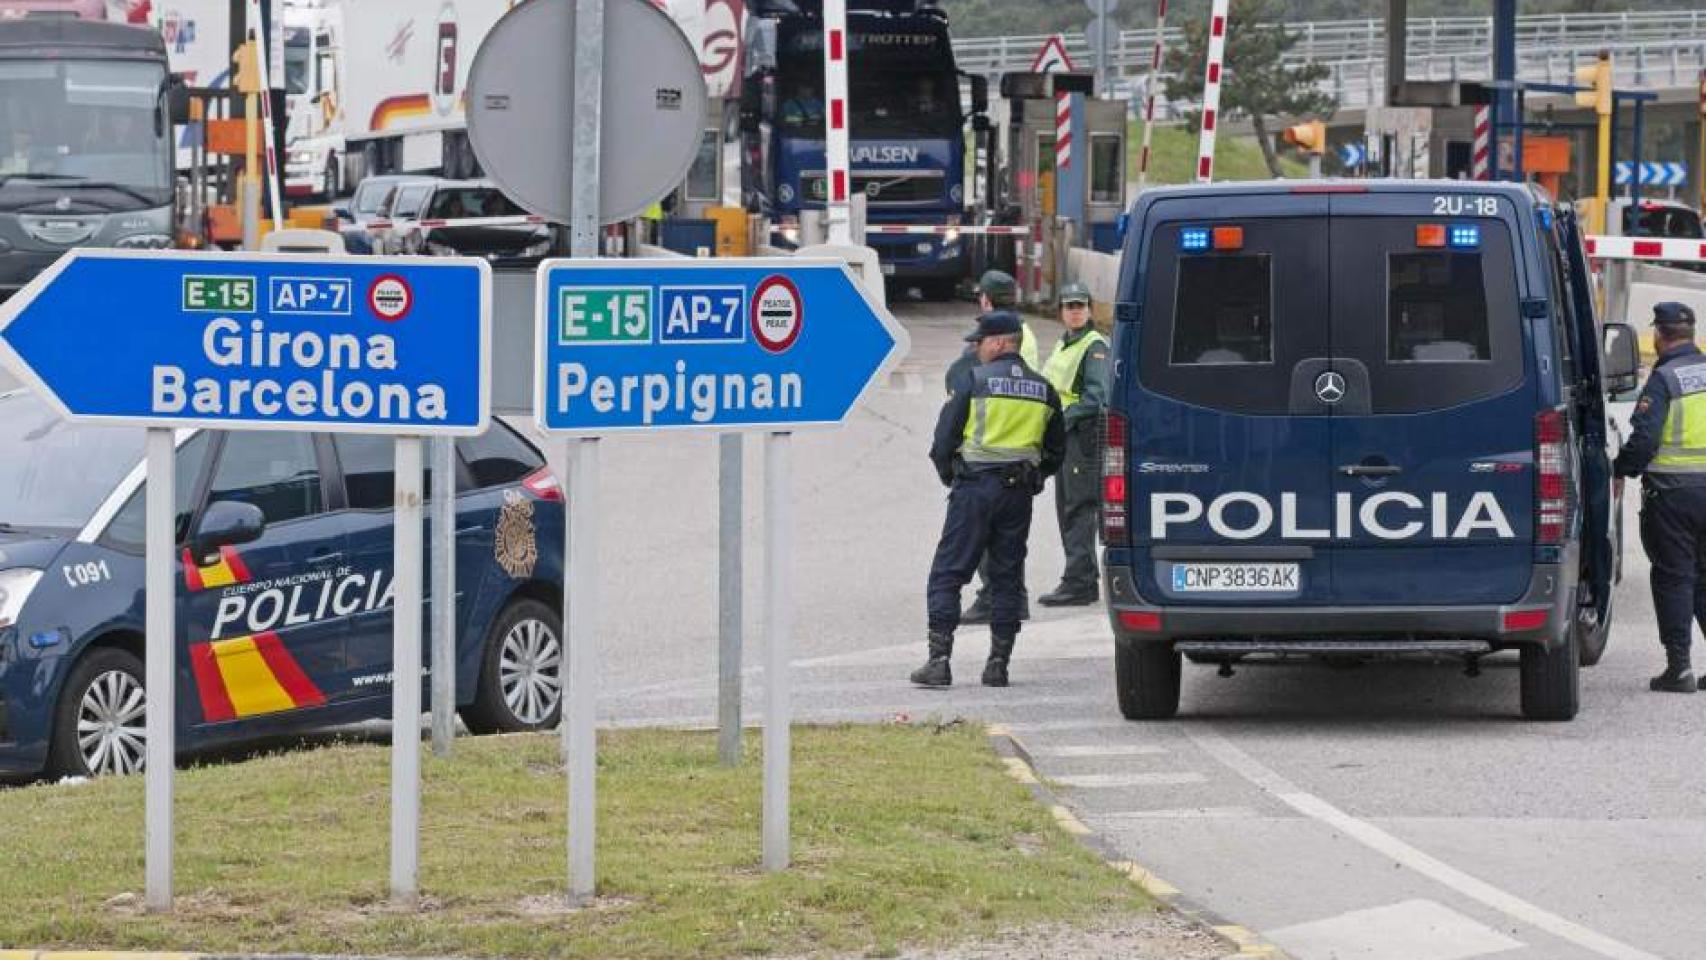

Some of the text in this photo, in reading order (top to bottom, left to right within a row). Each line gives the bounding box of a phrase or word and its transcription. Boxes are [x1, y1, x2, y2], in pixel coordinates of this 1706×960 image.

[1432, 196, 1499, 216] 2U-18
[187, 281, 346, 309] E-15 AP-7
[564, 293, 740, 337] E-15 AP-7
[202, 317, 398, 371] Girona
[152, 364, 448, 420] Barcelona
[558, 359, 803, 426] Perpignan
[1150, 491, 1516, 540] POLICIA
[336, 565, 353, 578] DE
